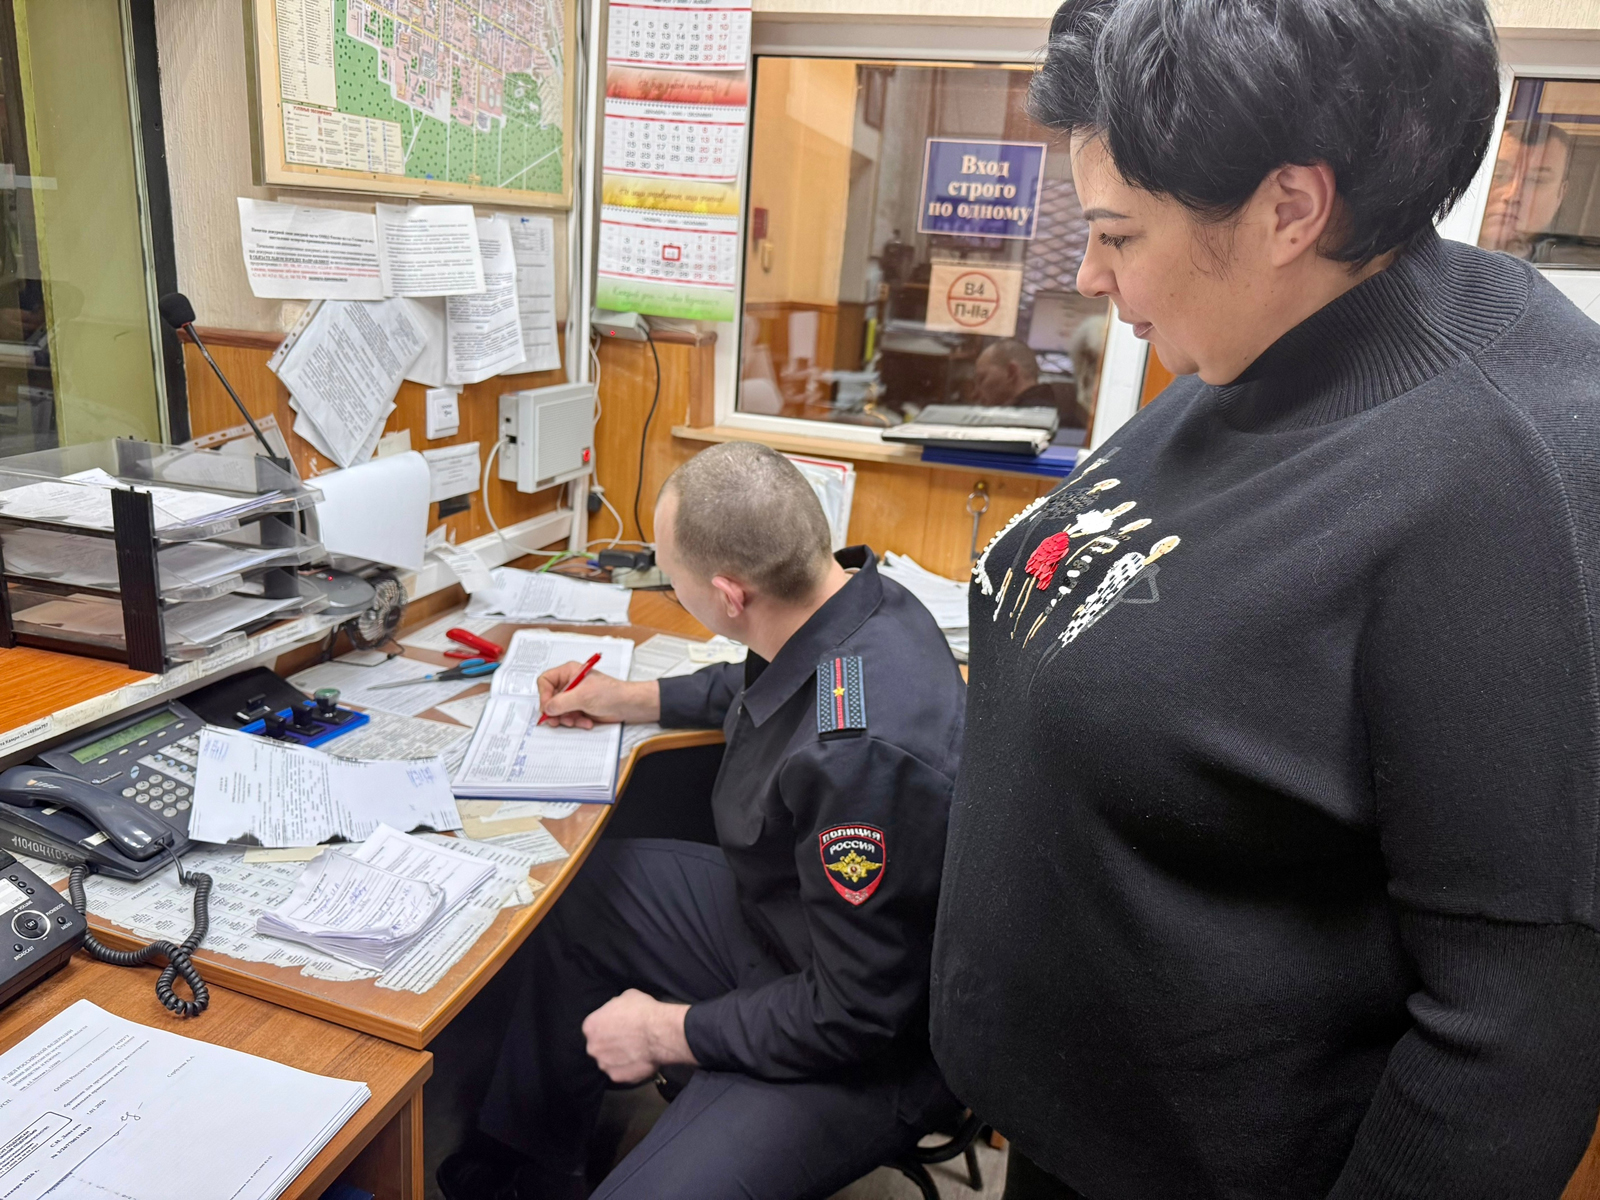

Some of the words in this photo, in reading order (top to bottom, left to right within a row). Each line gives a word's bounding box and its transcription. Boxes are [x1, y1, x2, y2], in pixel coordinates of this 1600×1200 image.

[961, 155, 1009, 177] Вход
[948, 182, 1016, 201] строго
[928, 202, 953, 217] по
[957, 204, 1032, 226] одному
[963, 282, 985, 296] В4
[822, 828, 881, 843] ПОЛИЦИЯ
[829, 840, 876, 855] РОССИЯ
[60, 921, 73, 930] MENU
[13, 945, 35, 961] BROADCAST
